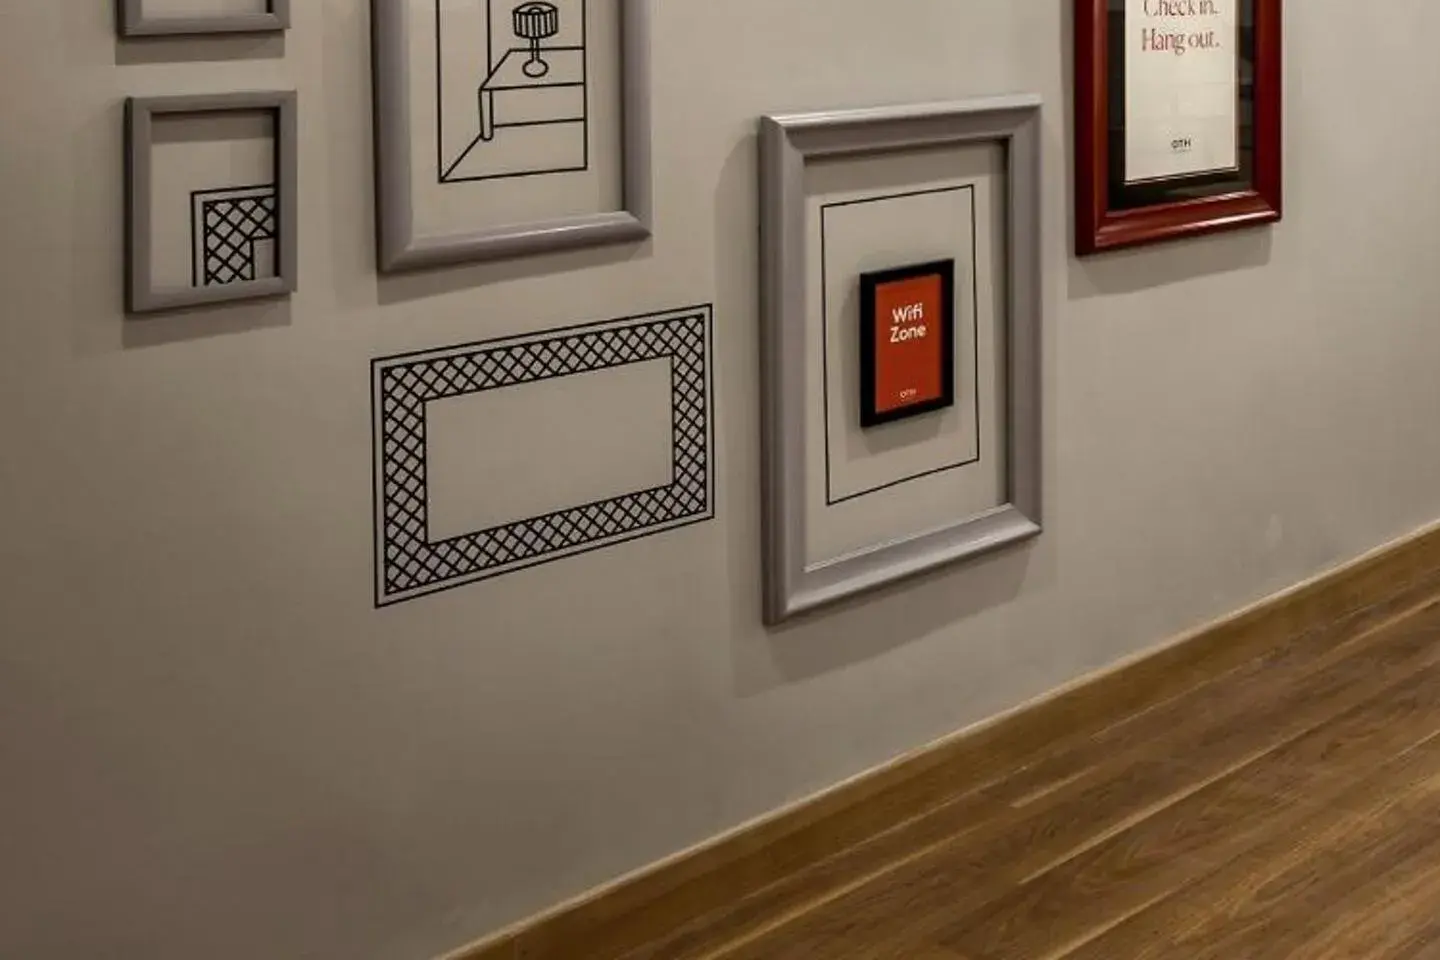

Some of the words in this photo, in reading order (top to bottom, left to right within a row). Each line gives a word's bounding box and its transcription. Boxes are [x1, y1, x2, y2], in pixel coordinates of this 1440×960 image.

[1142, 27, 1186, 56] Hang
[1188, 31, 1221, 49] out.
[892, 302, 923, 323] Wifi
[890, 325, 926, 343] Zone
